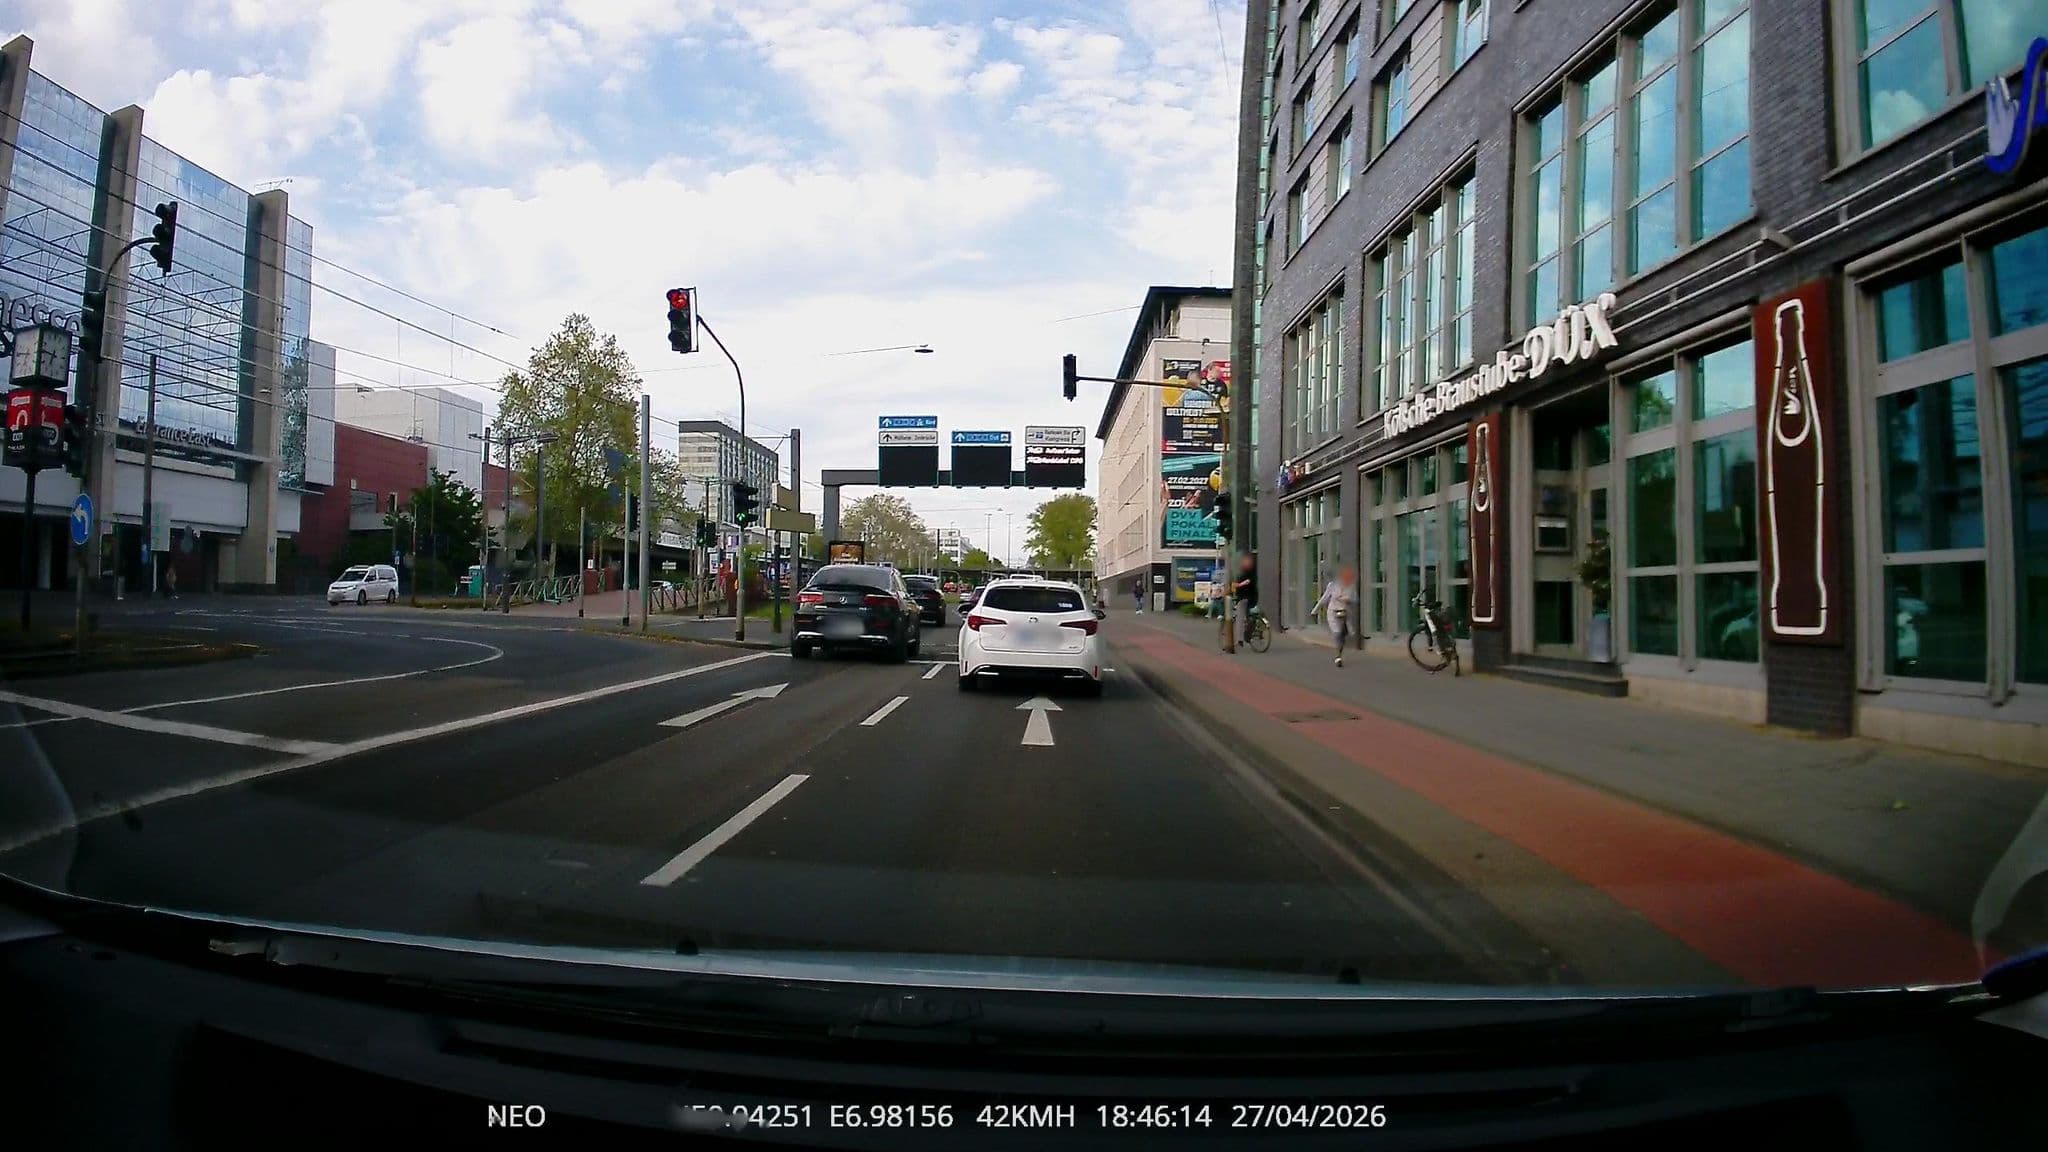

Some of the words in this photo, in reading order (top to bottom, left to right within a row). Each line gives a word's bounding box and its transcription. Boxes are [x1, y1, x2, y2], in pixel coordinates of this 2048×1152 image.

[1523, 292, 1620, 379] DÜX
[1171, 511, 1197, 519] DVV
[1171, 520, 1216, 529] POKAL
